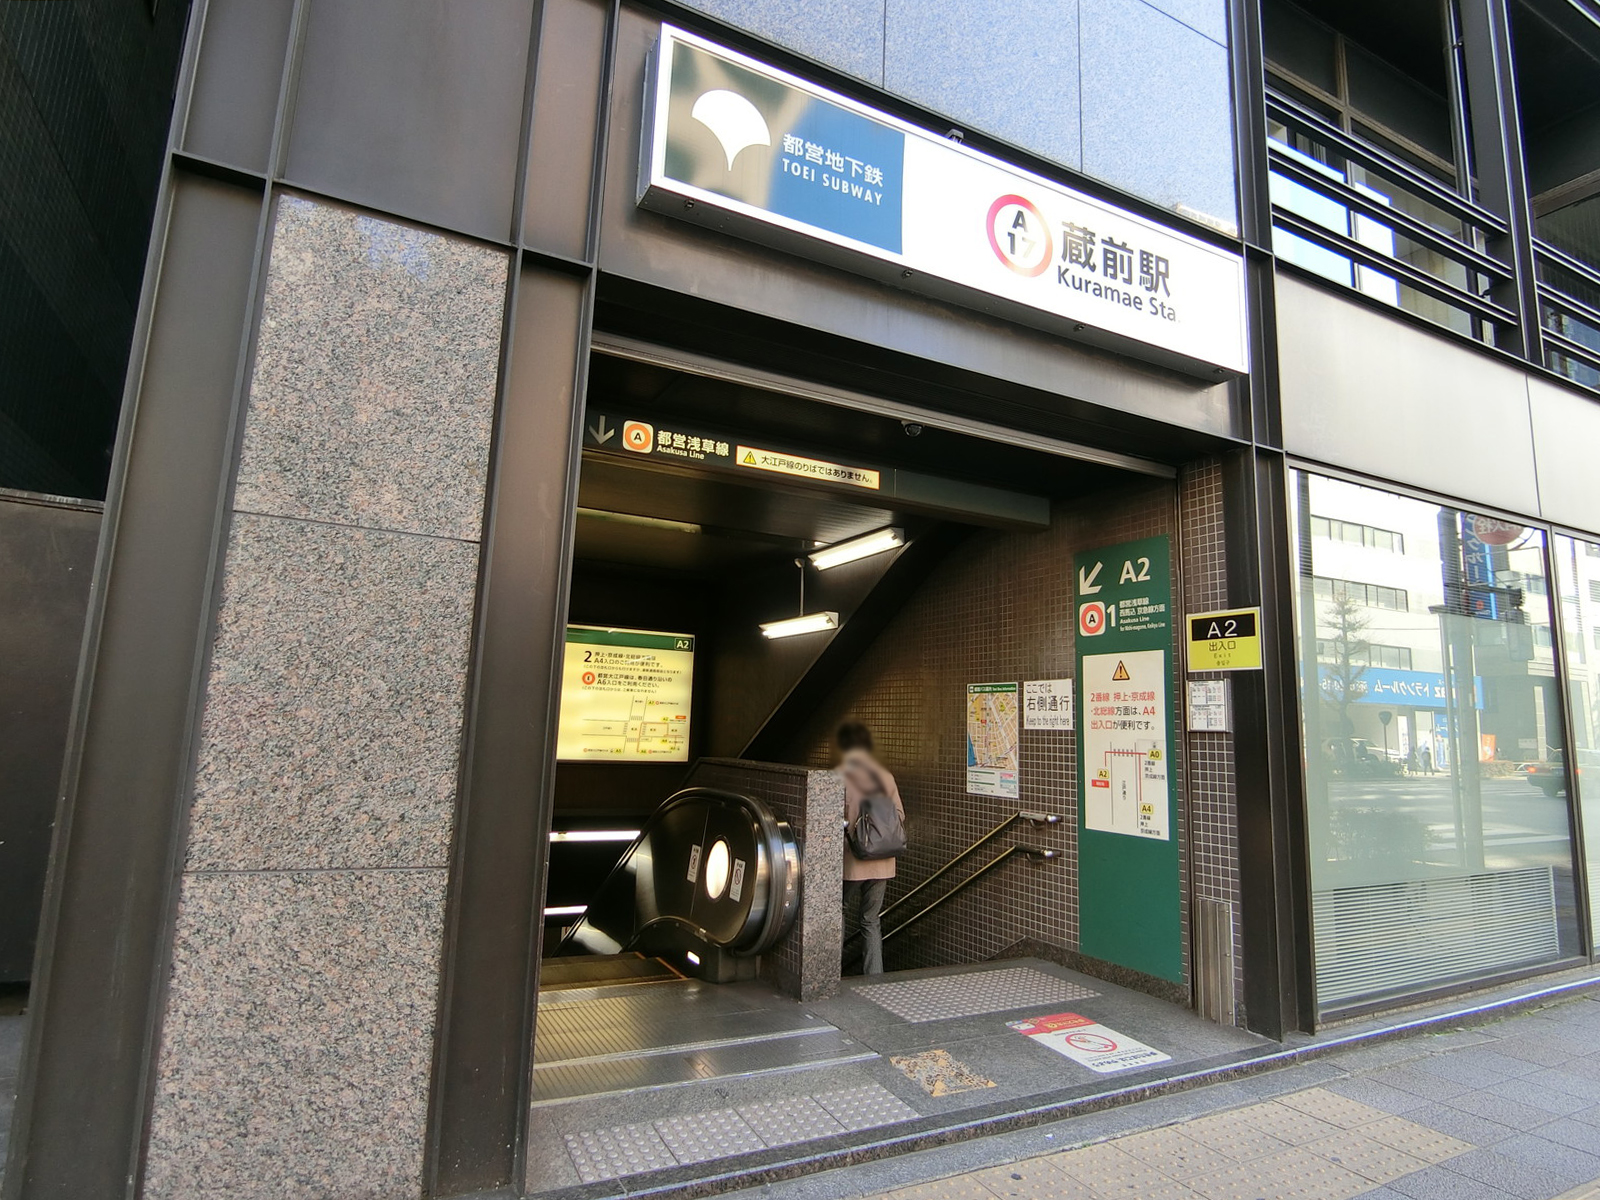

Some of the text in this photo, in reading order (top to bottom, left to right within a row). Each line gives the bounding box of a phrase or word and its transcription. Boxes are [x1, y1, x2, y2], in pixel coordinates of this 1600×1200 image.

[783, 133, 884, 187] 都営地下鉄
[782, 158, 883, 206] TOEI SUBWAY
[1012, 210, 1029, 233] A
[1007, 231, 1037, 259] 17
[1061, 220, 1171, 298] 蔵前駅
[1057, 265, 1144, 311] Kuramae
[633, 432, 643, 442] A
[657, 430, 730, 457] 都営浅草線
[656, 445, 705, 460] Asakusa Line
[761, 455, 873, 483] 大江戸線のりばではありません。
[1119, 557, 1151, 585] A2
[1088, 604, 1117, 627] A 1
[1207, 619, 1238, 639] A2
[676, 640, 690, 650] A2
[1208, 640, 1237, 652] 出入口
[583, 650, 593, 663] 2
[1026, 683, 1052, 694] ここでは
[1090, 690, 1156, 703] 2番線 押上・京成線
[1026, 695, 1070, 712] 右側通行
[1026, 716, 1036, 727] Keep
[1037, 717, 1042, 725] to
[1049, 715, 1059, 728] right
[1060, 716, 1070, 725] here
[1090, 719, 1155, 731] 出入口が便利です。
[1098, 770, 1108, 778] A2
[1141, 805, 1151, 813] A4
